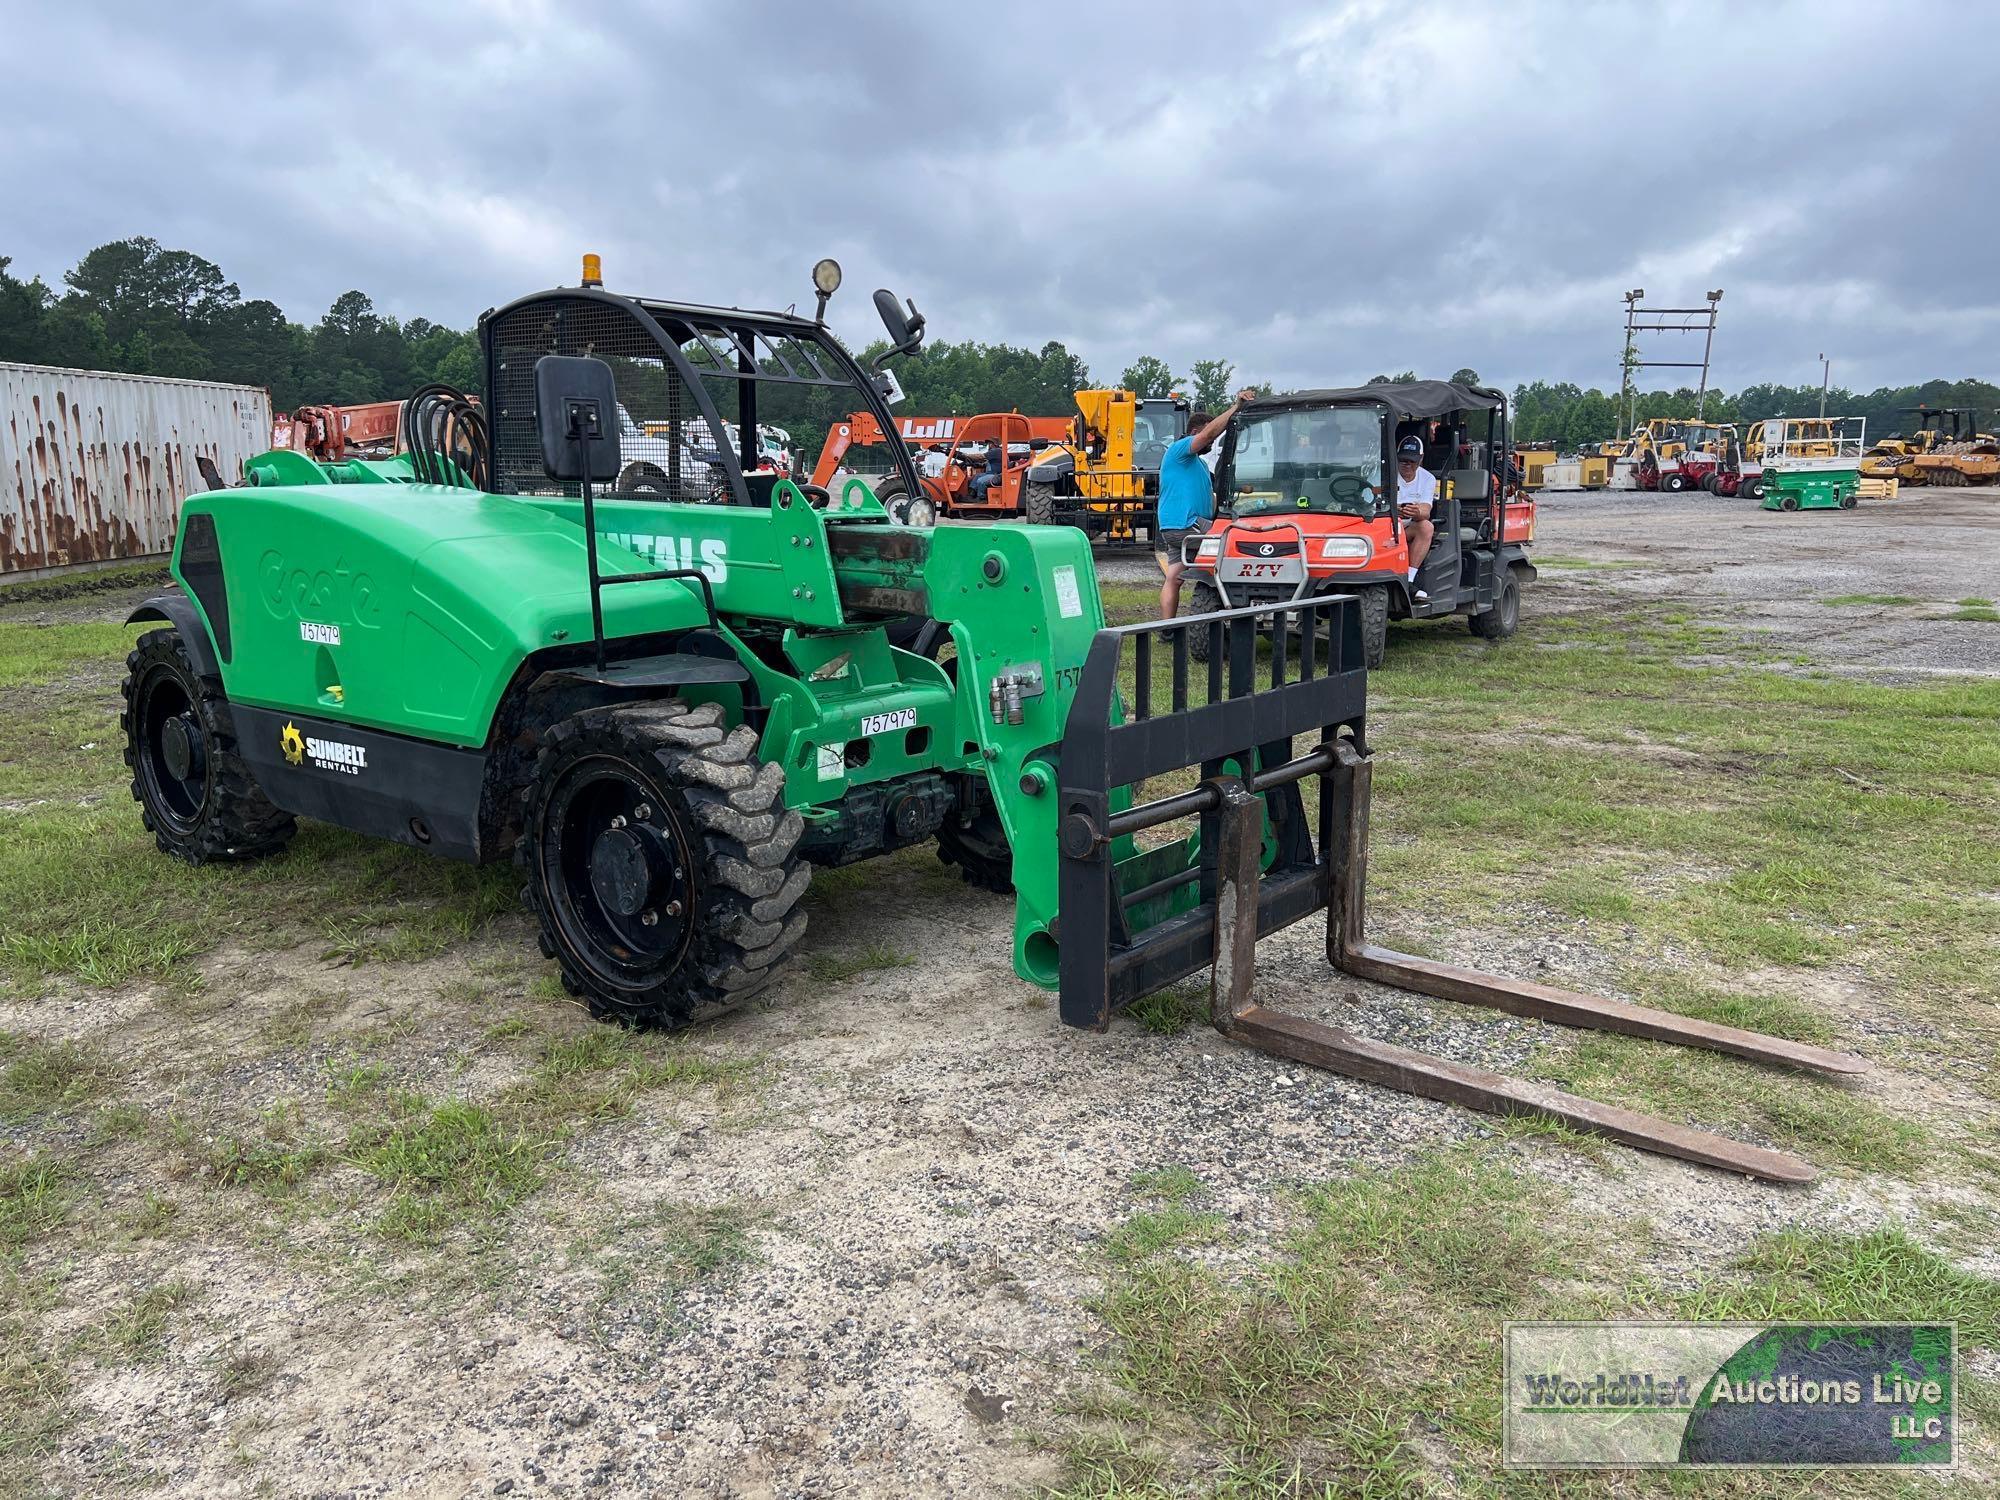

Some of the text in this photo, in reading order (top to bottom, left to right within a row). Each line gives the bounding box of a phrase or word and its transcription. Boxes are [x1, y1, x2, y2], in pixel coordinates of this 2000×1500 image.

[902, 419, 955, 438] Lull
[595, 532, 727, 584] TALS
[1237, 563, 1284, 577] RTV
[301, 622, 340, 643] 757979
[1055, 666, 1084, 691] 757
[862, 708, 916, 735] 757979
[306, 736, 366, 768] SUNBELT
[315, 758, 359, 775] RENTALS
